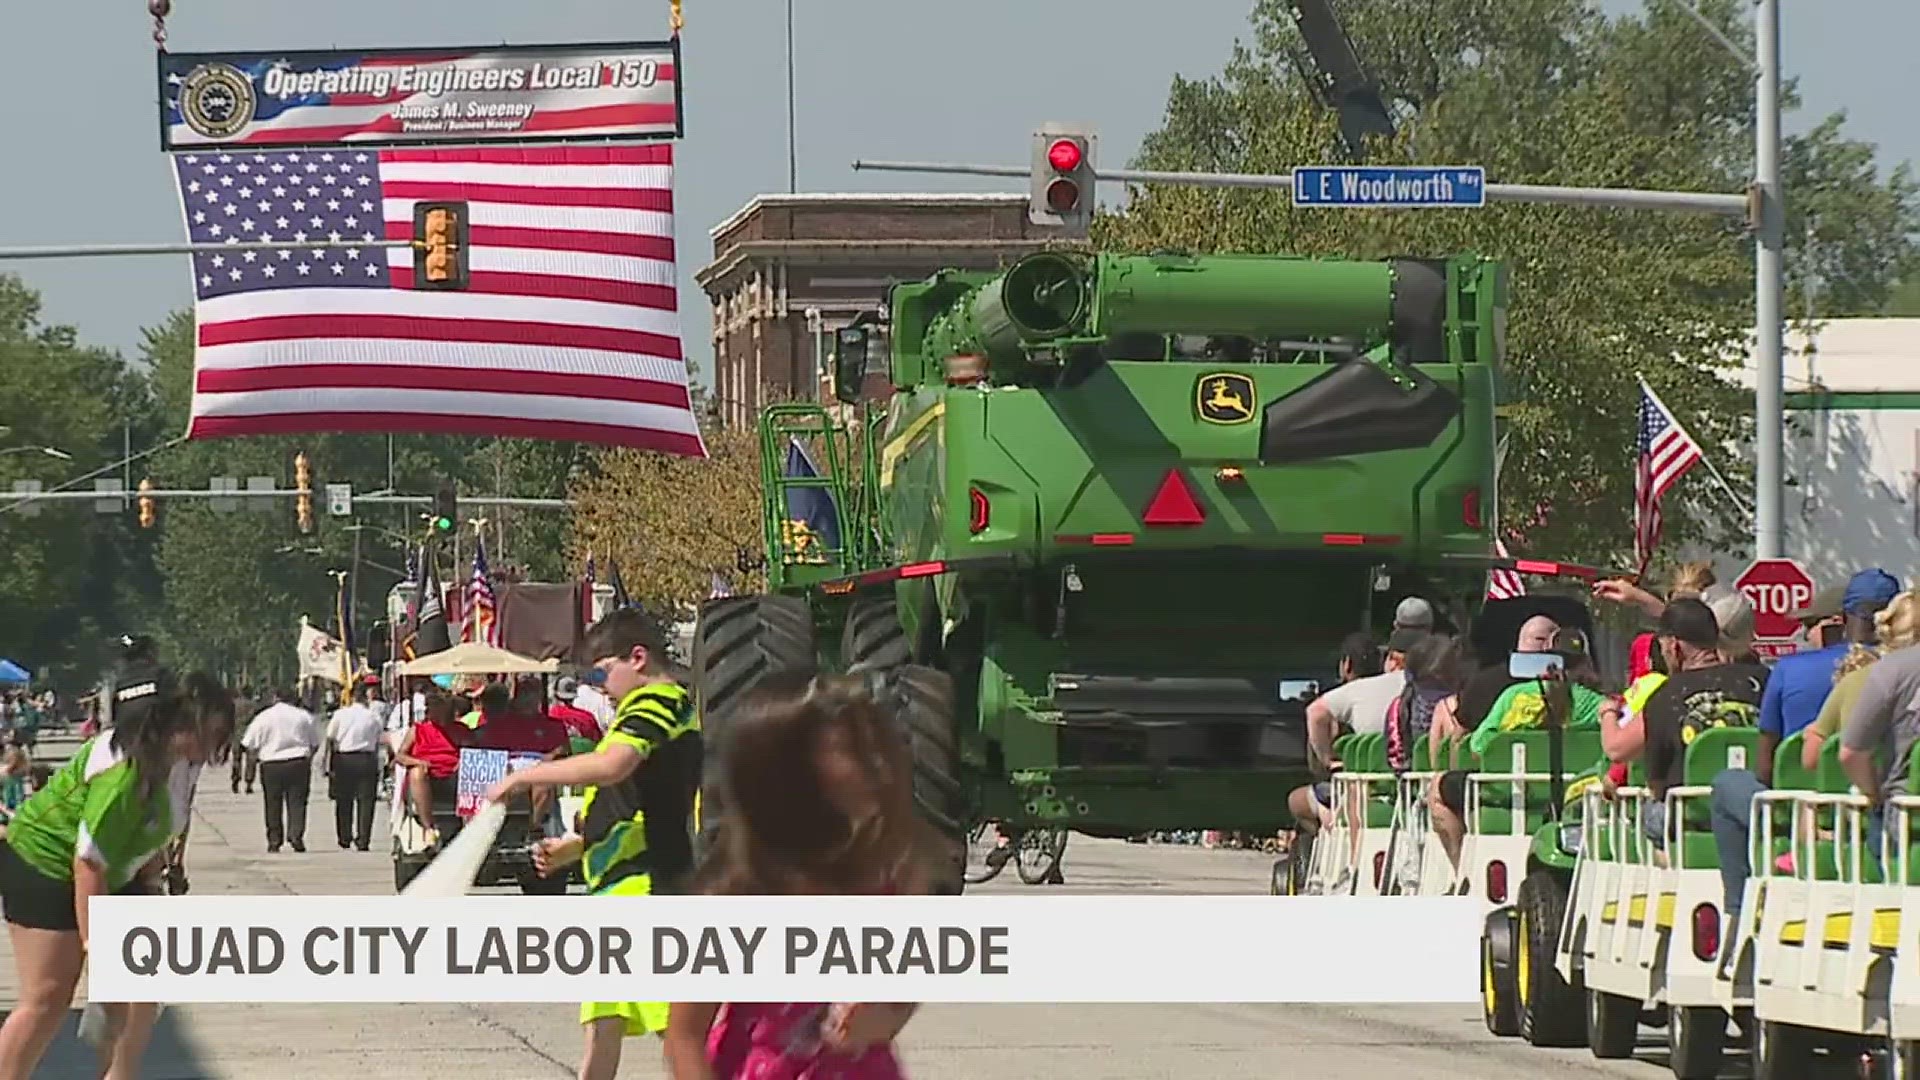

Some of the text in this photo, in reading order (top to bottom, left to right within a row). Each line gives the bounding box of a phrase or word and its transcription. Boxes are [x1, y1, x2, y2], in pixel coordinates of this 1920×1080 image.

[264, 59, 657, 99] Operating Engineers Local 150
[392, 101, 533, 119] James M. Sweeney
[403, 120, 443, 132] President
[486, 119, 522, 131] Manager
[1297, 171, 1480, 201] L E Woodworth Way
[1741, 583, 1809, 614] STOP
[462, 749, 506, 766] EXPAND
